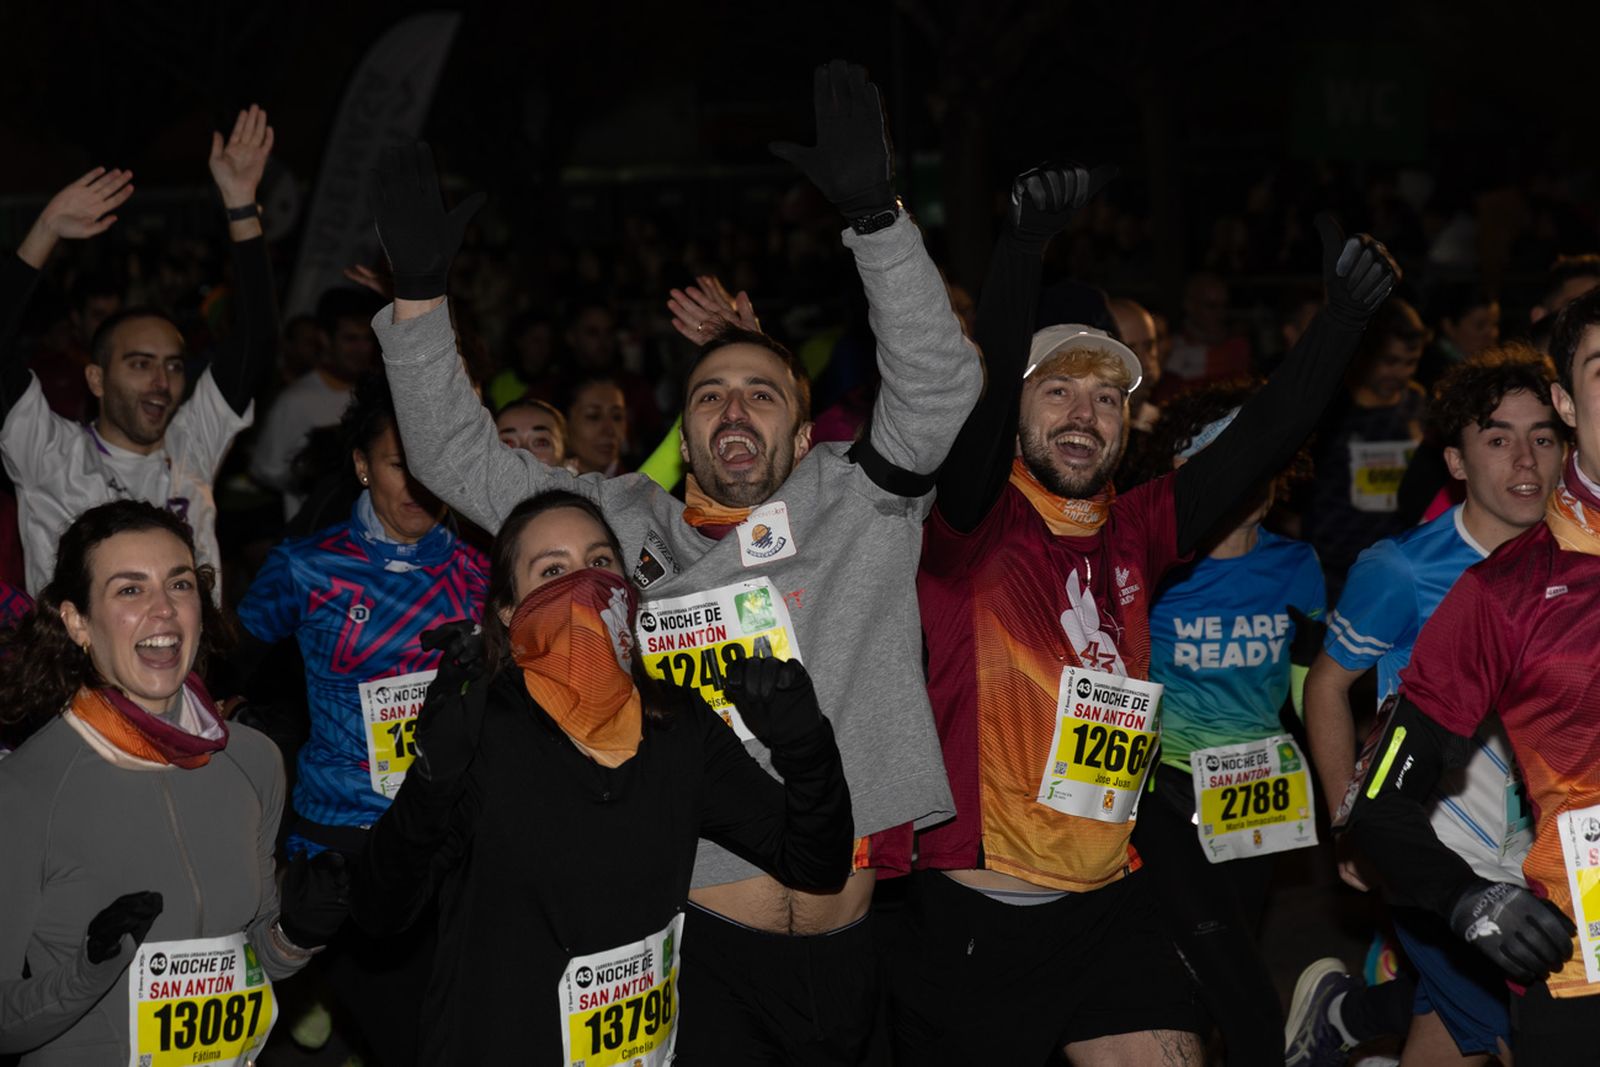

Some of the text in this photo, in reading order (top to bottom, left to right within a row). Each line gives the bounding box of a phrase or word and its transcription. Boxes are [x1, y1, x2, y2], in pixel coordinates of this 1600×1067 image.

[641, 607, 722, 631] 43 NOCHE DE
[1173, 614, 1290, 640] WE ARE
[648, 636, 675, 653] SAN
[678, 623, 727, 649] ANTÓN
[1174, 639, 1286, 671] READY
[394, 687, 426, 703] NOCH
[1077, 682, 1149, 712] 43 NOCHE DE
[380, 705, 406, 722] SAN
[1074, 703, 1146, 730] SAN ANTÓN
[1221, 757, 1255, 771] NOCHE
[1255, 753, 1269, 764] DE
[1210, 775, 1233, 788] SAN
[1221, 778, 1290, 821] 2788
[150, 955, 236, 976] 43 NOCHE DE
[576, 953, 654, 986] 43 NOCHE DE
[149, 980, 182, 999] SAN
[184, 972, 235, 996] ANTÓN
[579, 988, 609, 1011] SAN
[612, 971, 654, 1002] ANTÓN
[153, 990, 263, 1052] 13087
[584, 979, 671, 1056] 13798
[192, 1049, 221, 1063] Fátima
[621, 1041, 654, 1060] Camelia
